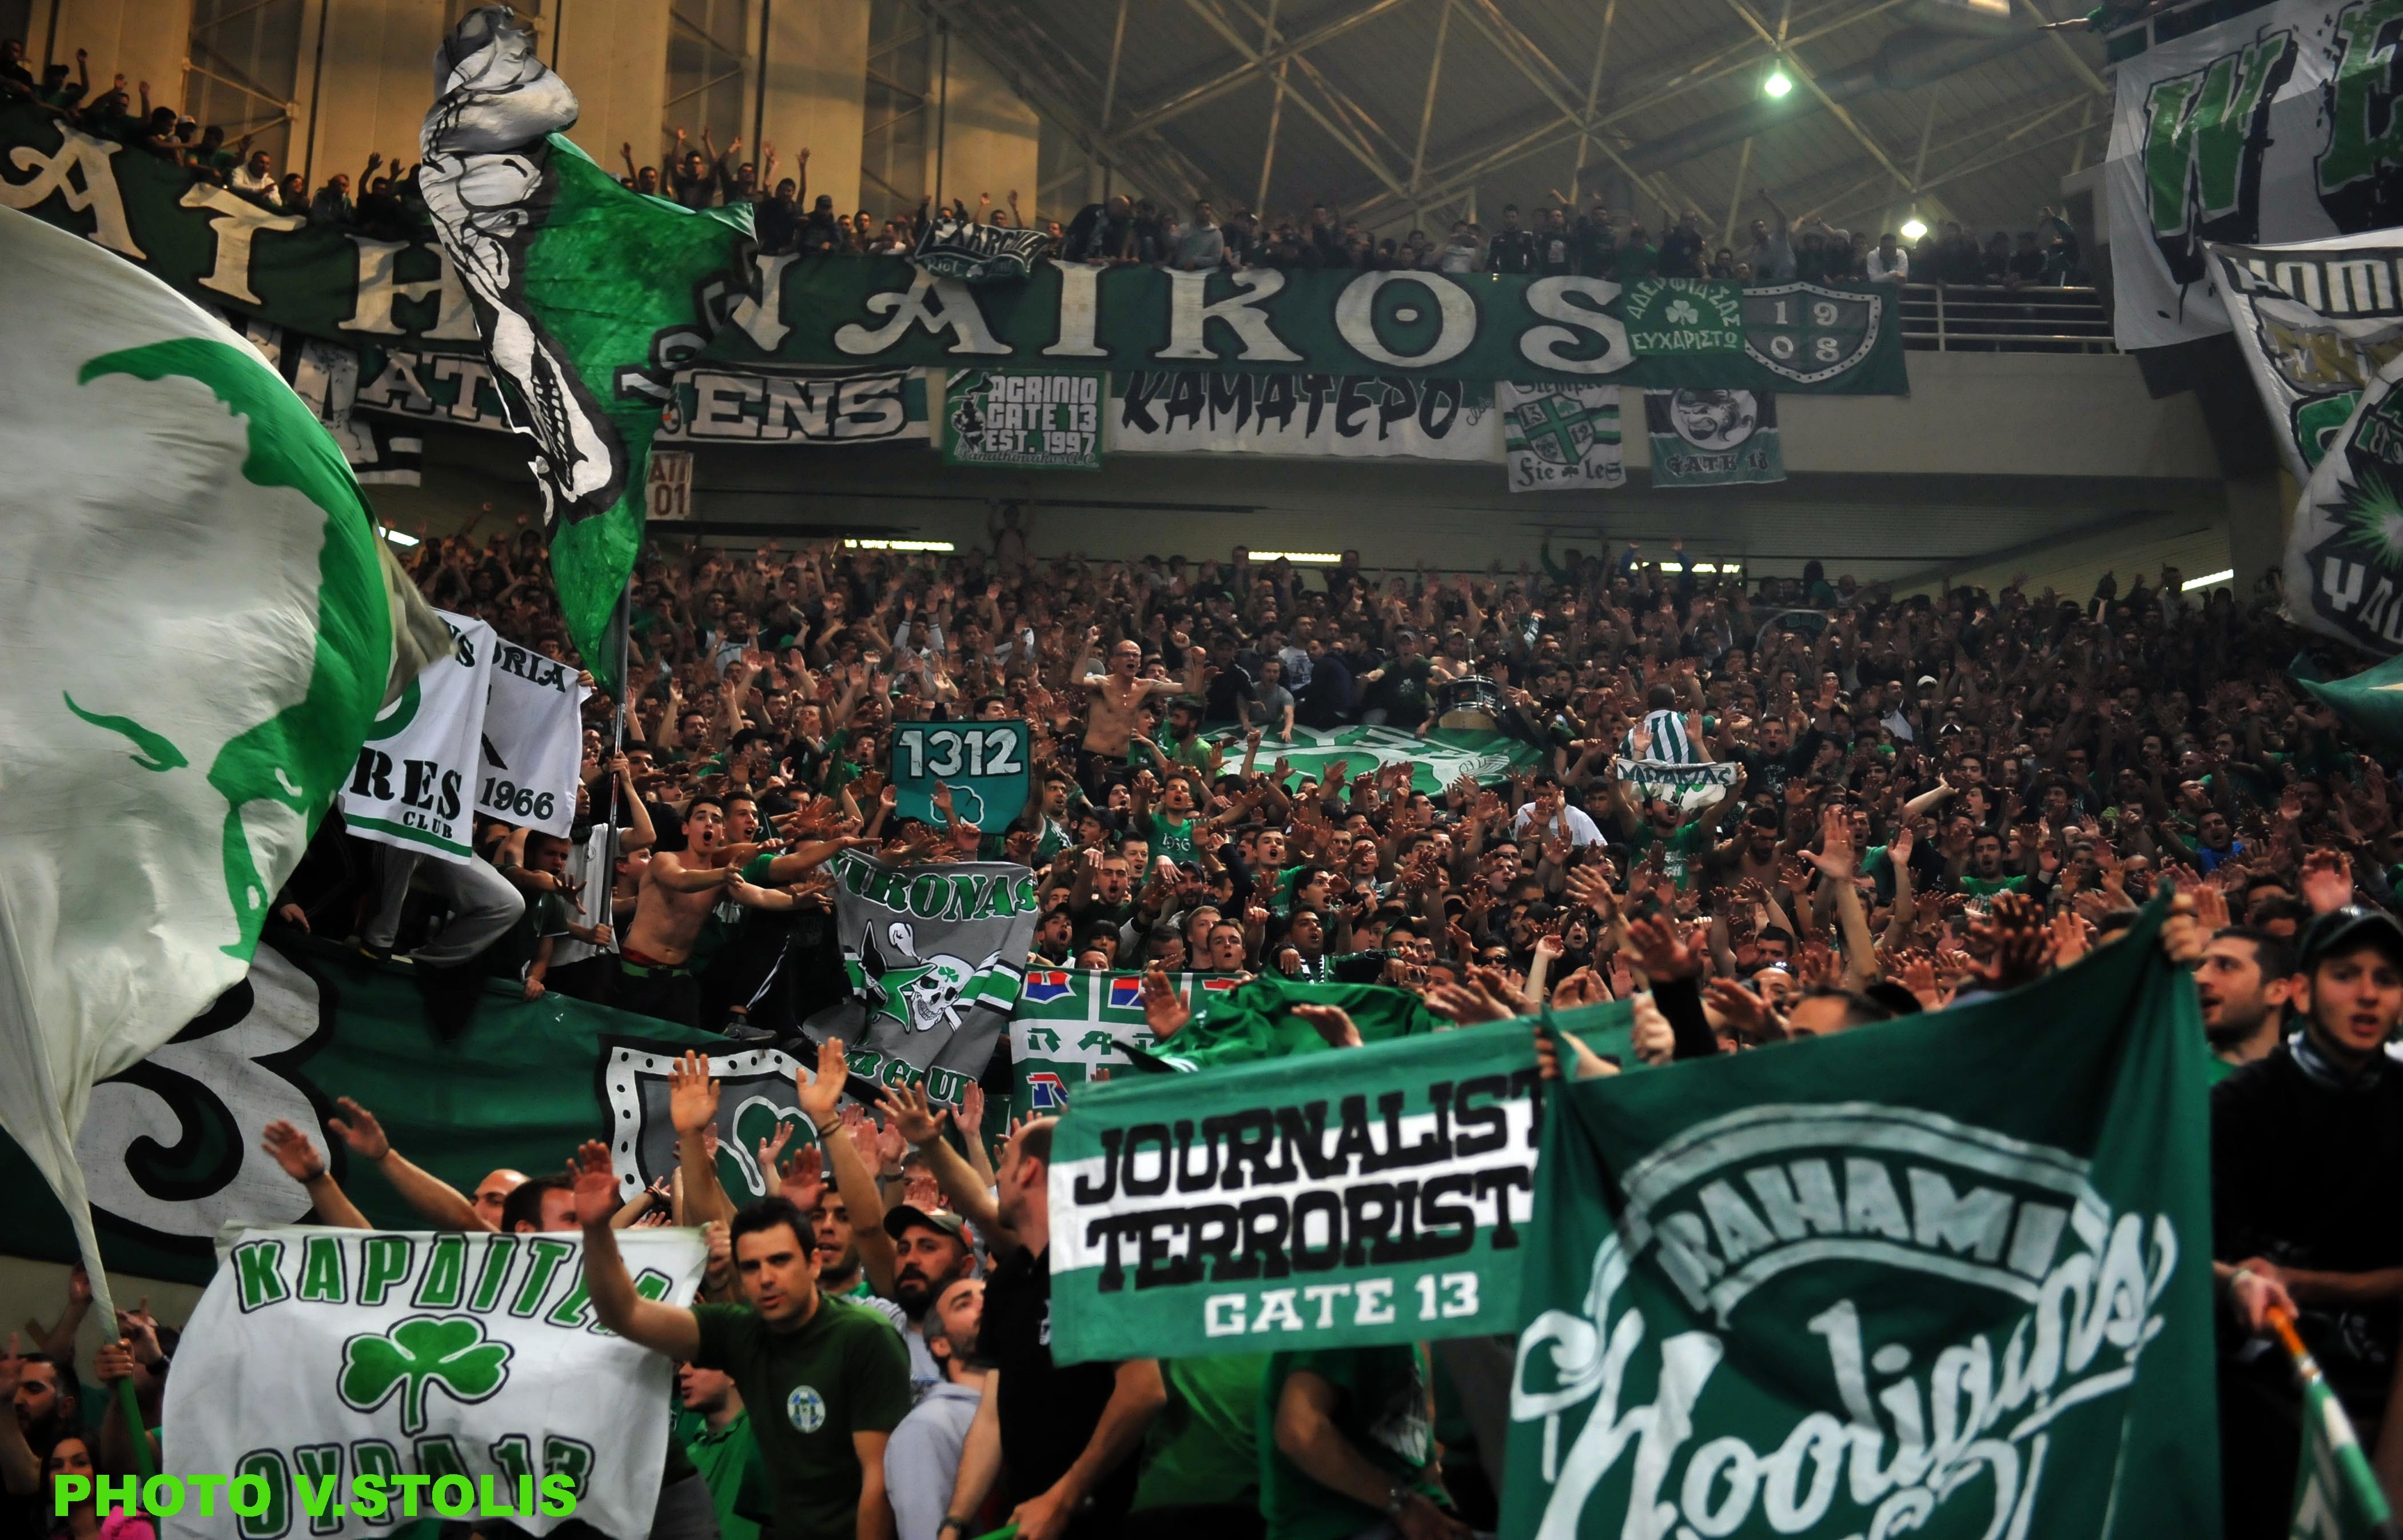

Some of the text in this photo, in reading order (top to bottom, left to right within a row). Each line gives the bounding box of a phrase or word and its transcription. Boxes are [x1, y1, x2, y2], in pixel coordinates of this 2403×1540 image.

[987, 375, 1098, 404] AGRINIO
[986, 402, 1097, 432] GATE 13
[986, 429, 1095, 456] EST. 1997
[896, 727, 1022, 780] 1312
[478, 777, 555, 821] 1966
[403, 810, 453, 839] CLUB
[1086, 1166, 1529, 1293] TERRORIST
[1204, 1272, 1480, 1338] GATE 13
